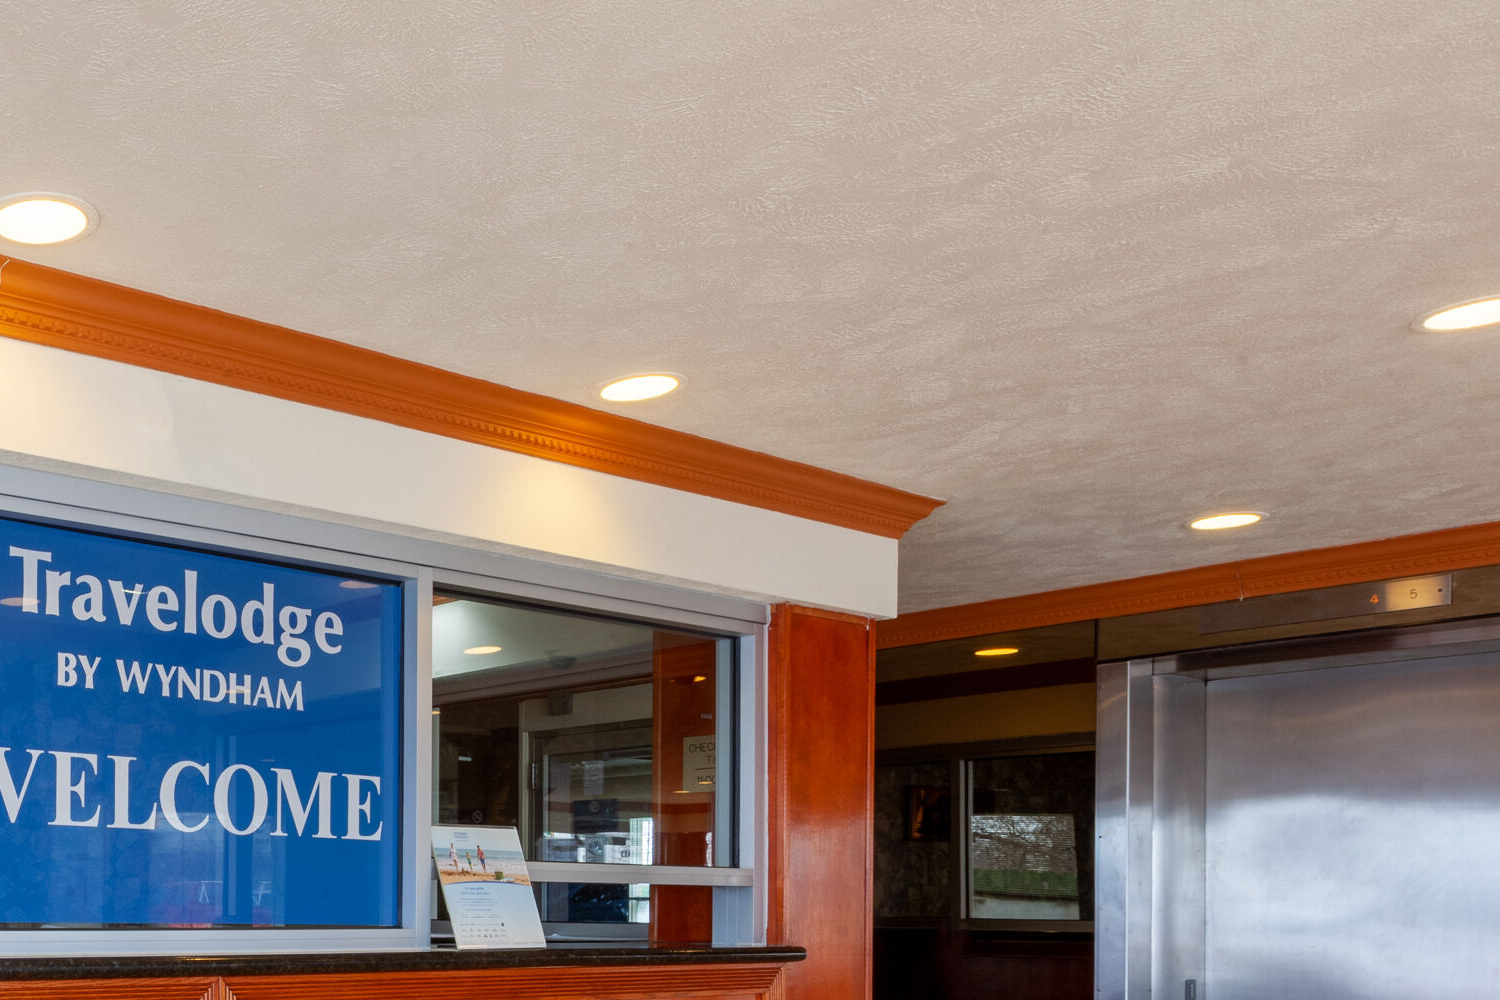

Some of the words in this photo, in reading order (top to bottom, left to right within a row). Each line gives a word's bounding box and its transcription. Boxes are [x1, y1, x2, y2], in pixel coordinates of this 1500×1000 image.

[9, 546, 344, 668] Travelodge
[1409, 588, 1418, 599] 5
[57, 652, 101, 690] BY
[116, 659, 305, 712] WYNDHAM
